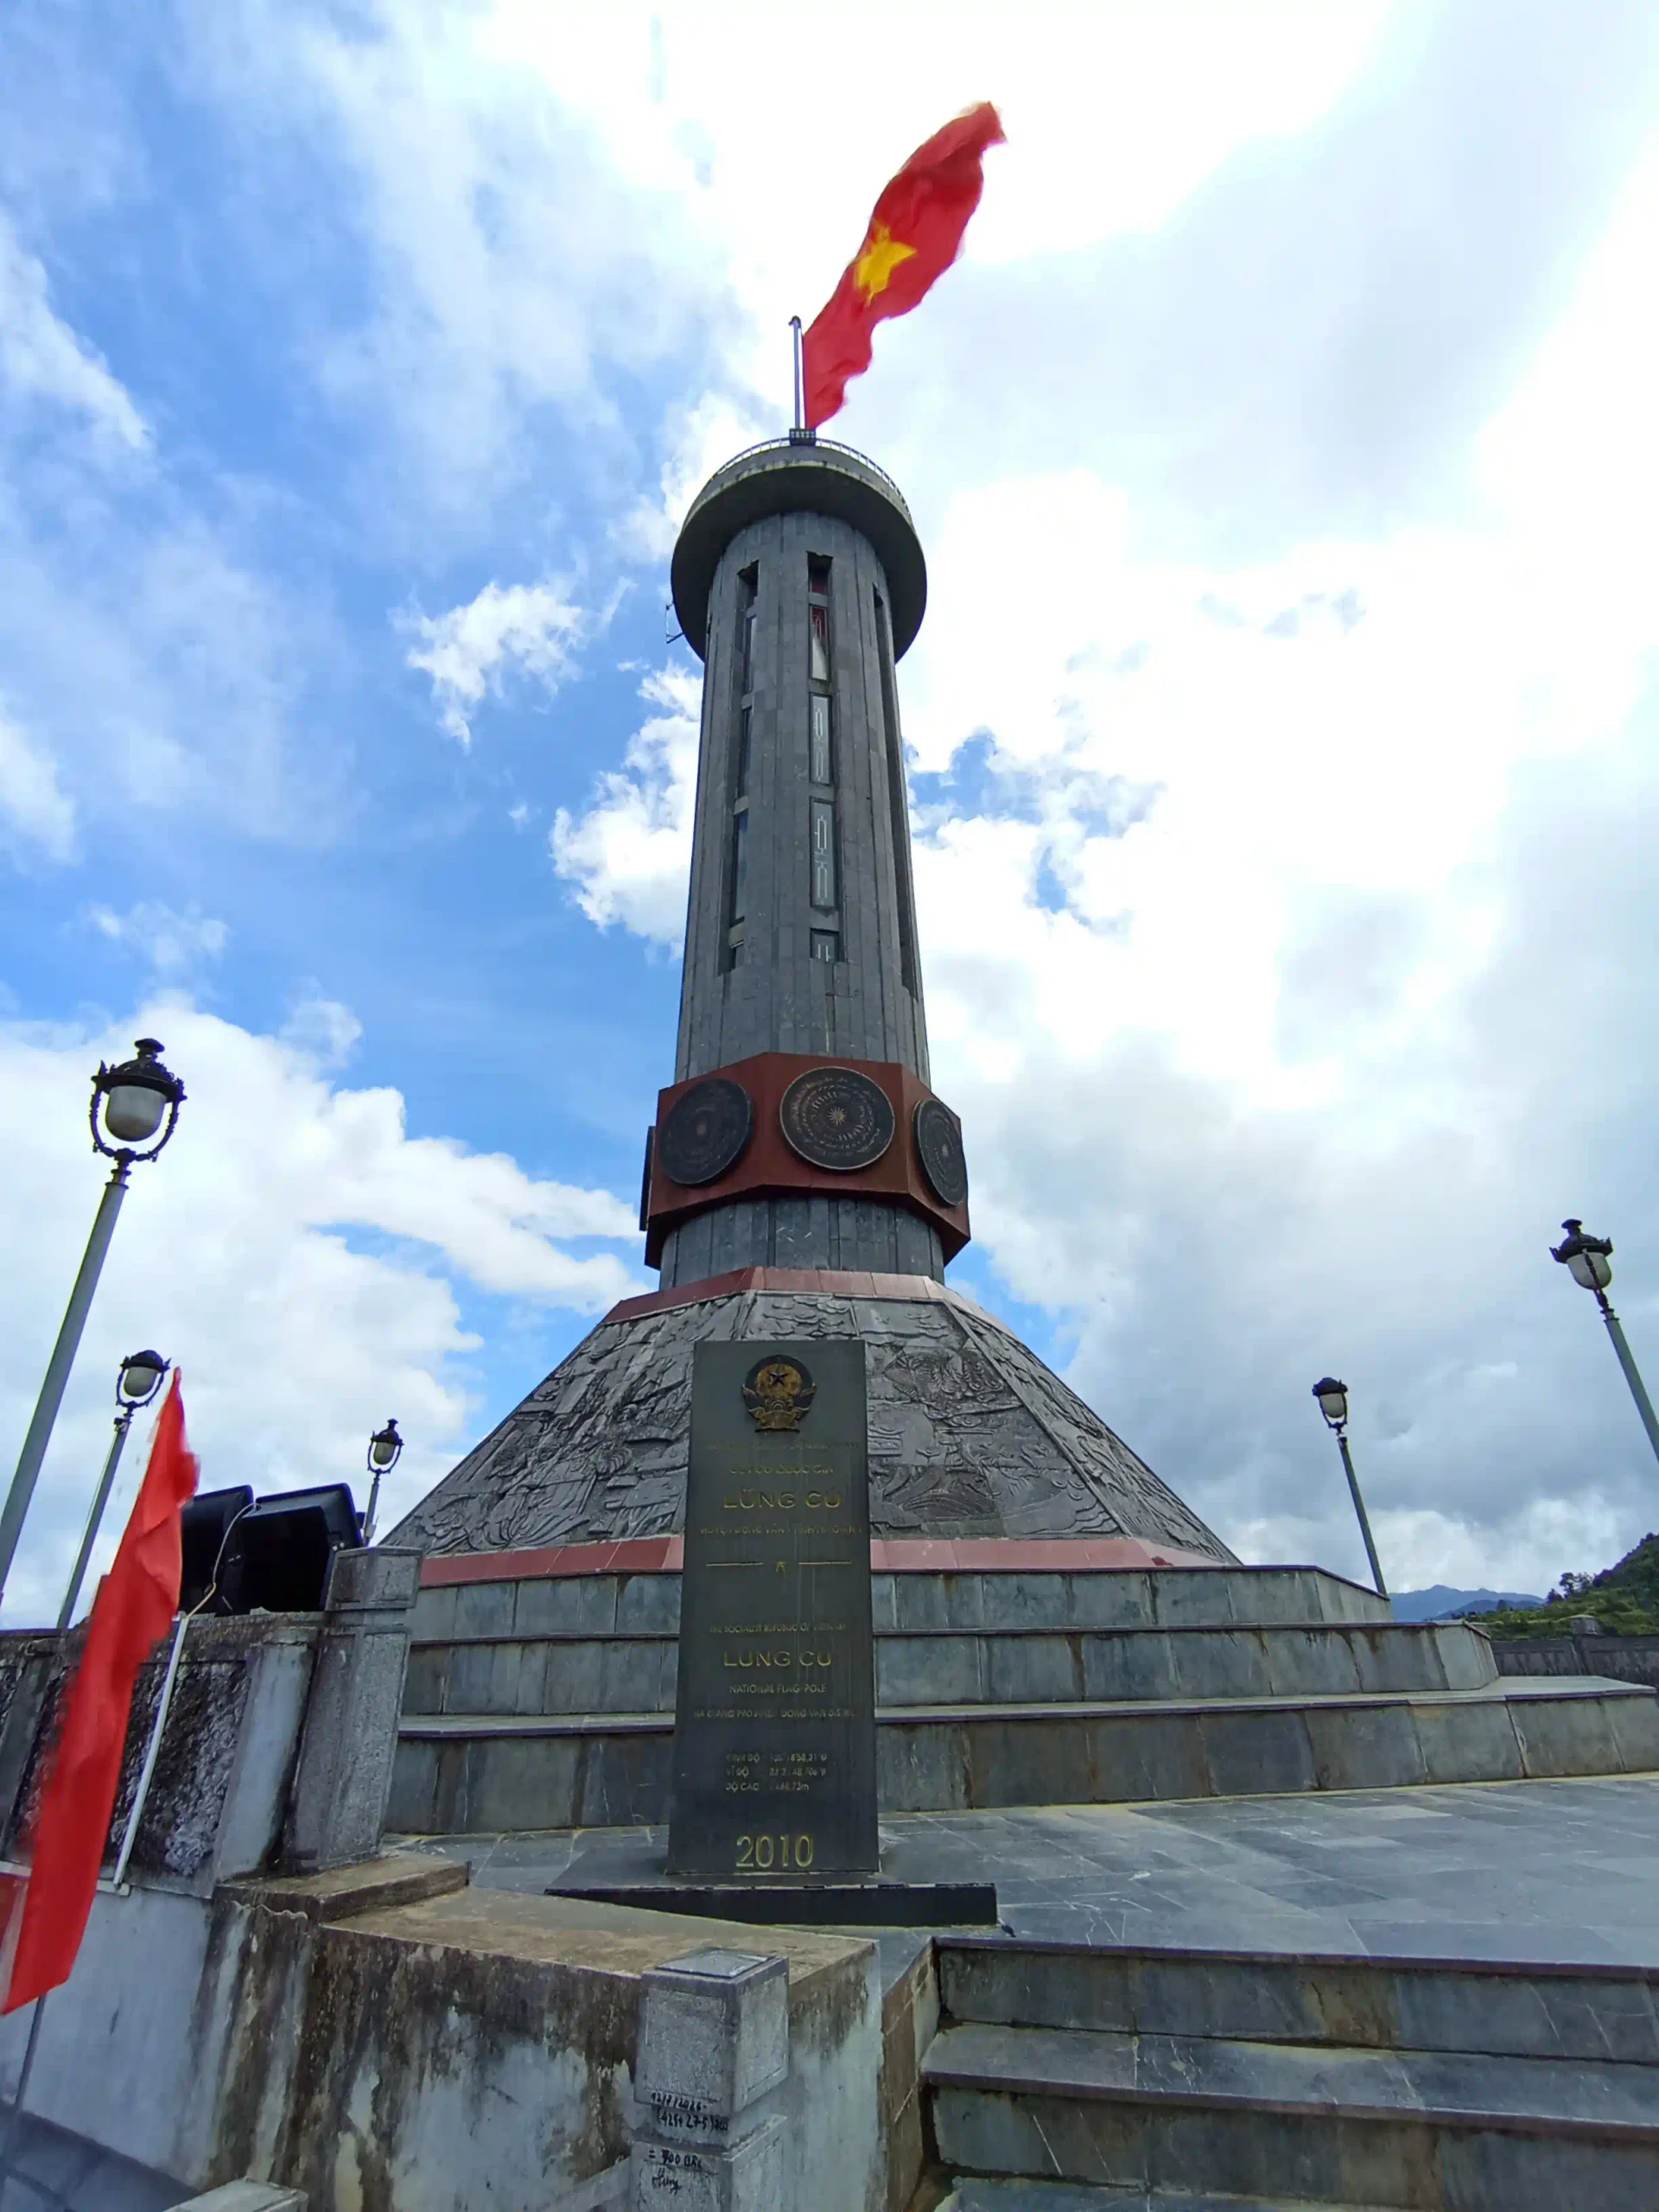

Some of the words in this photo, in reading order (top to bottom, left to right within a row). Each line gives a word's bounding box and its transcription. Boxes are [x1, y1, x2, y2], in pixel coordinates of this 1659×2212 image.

[723, 1487, 796, 1510] LŨNG
[723, 1650, 791, 1668] LUNG
[798, 1650, 833, 1668] CU
[729, 1683, 775, 1694] NATIONAL
[804, 1683, 827, 1694] POLE
[736, 1835, 814, 1868] 2010
